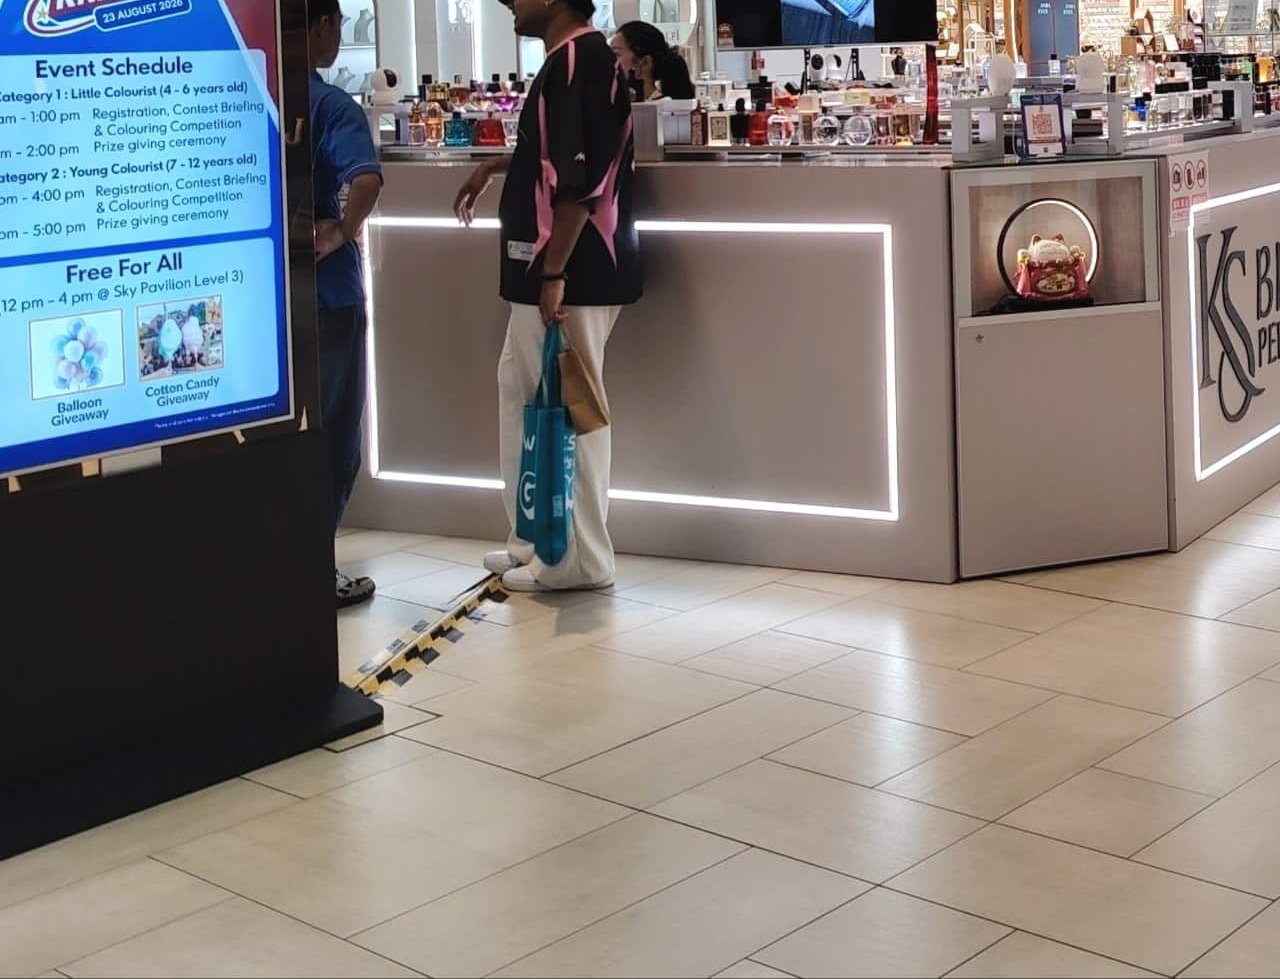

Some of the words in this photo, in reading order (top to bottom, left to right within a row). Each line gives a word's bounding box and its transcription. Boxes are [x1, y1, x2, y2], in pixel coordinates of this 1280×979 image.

[103, 11, 115, 23] 23
[117, 3, 157, 20] AUGUST
[36, 59, 96, 79] Event
[102, 56, 193, 76] Schedule
[0, 91, 53, 104] ategory
[71, 86, 101, 100] Little
[104, 84, 158, 99] Colourist
[159, 83, 174, 97] (4
[182, 84, 190, 95] 6
[193, 84, 223, 98] years
[226, 82, 248, 96] old)
[30, 109, 56, 123] 1:00
[60, 111, 81, 125] pm
[92, 106, 170, 121] Registration,
[173, 102, 219, 116] Contest
[221, 100, 265, 115] Briefing
[94, 125, 103, 137] &
[107, 122, 167, 138] Colouring
[170, 118, 242, 134] Competition
[26, 143, 56, 158] 2:00
[59, 144, 80, 159] pm
[94, 138, 125, 153] Prize
[128, 136, 166, 152] giving
[169, 133, 227, 150] ceremony
[51, 167, 60, 180] 2
[70, 164, 108, 181] Young
[111, 160, 163, 176] Colourist
[166, 158, 177, 173] (7
[188, 157, 201, 170] 12
[203, 155, 234, 171] years
[236, 152, 257, 167] old)
[31, 188, 61, 203] 4:00
[64, 188, 85, 204] pm
[96, 182, 173, 198] Registration,
[175, 176, 221, 191] Contest
[223, 171, 267, 187] Briefing
[97, 202, 105, 214] &
[109, 196, 168, 214] Colouring
[172, 189, 243, 209] Competition
[33, 222, 62, 237] 5:00
[66, 221, 86, 237] pm
[97, 216, 127, 232] Prize
[131, 212, 168, 228] giving
[172, 206, 229, 225] ceremony
[66, 264, 112, 284] Free
[119, 259, 151, 278] For
[156, 252, 182, 272] All
[1, 298, 17, 314] 12
[21, 298, 44, 314] pm
[58, 291, 68, 305] 4
[71, 292, 93, 307] pm
[97, 288, 110, 301] @
[114, 283, 137, 299] Sky
[141, 278, 191, 295] Pavilion
[194, 272, 229, 288] Level
[231, 269, 244, 285] 3)
[145, 382, 184, 399] Cotton
[186, 375, 220, 393] Candy
[156, 388, 211, 408] Giveaway
[51, 406, 109, 427] Giveaway
[57, 396, 103, 414] Balloon
